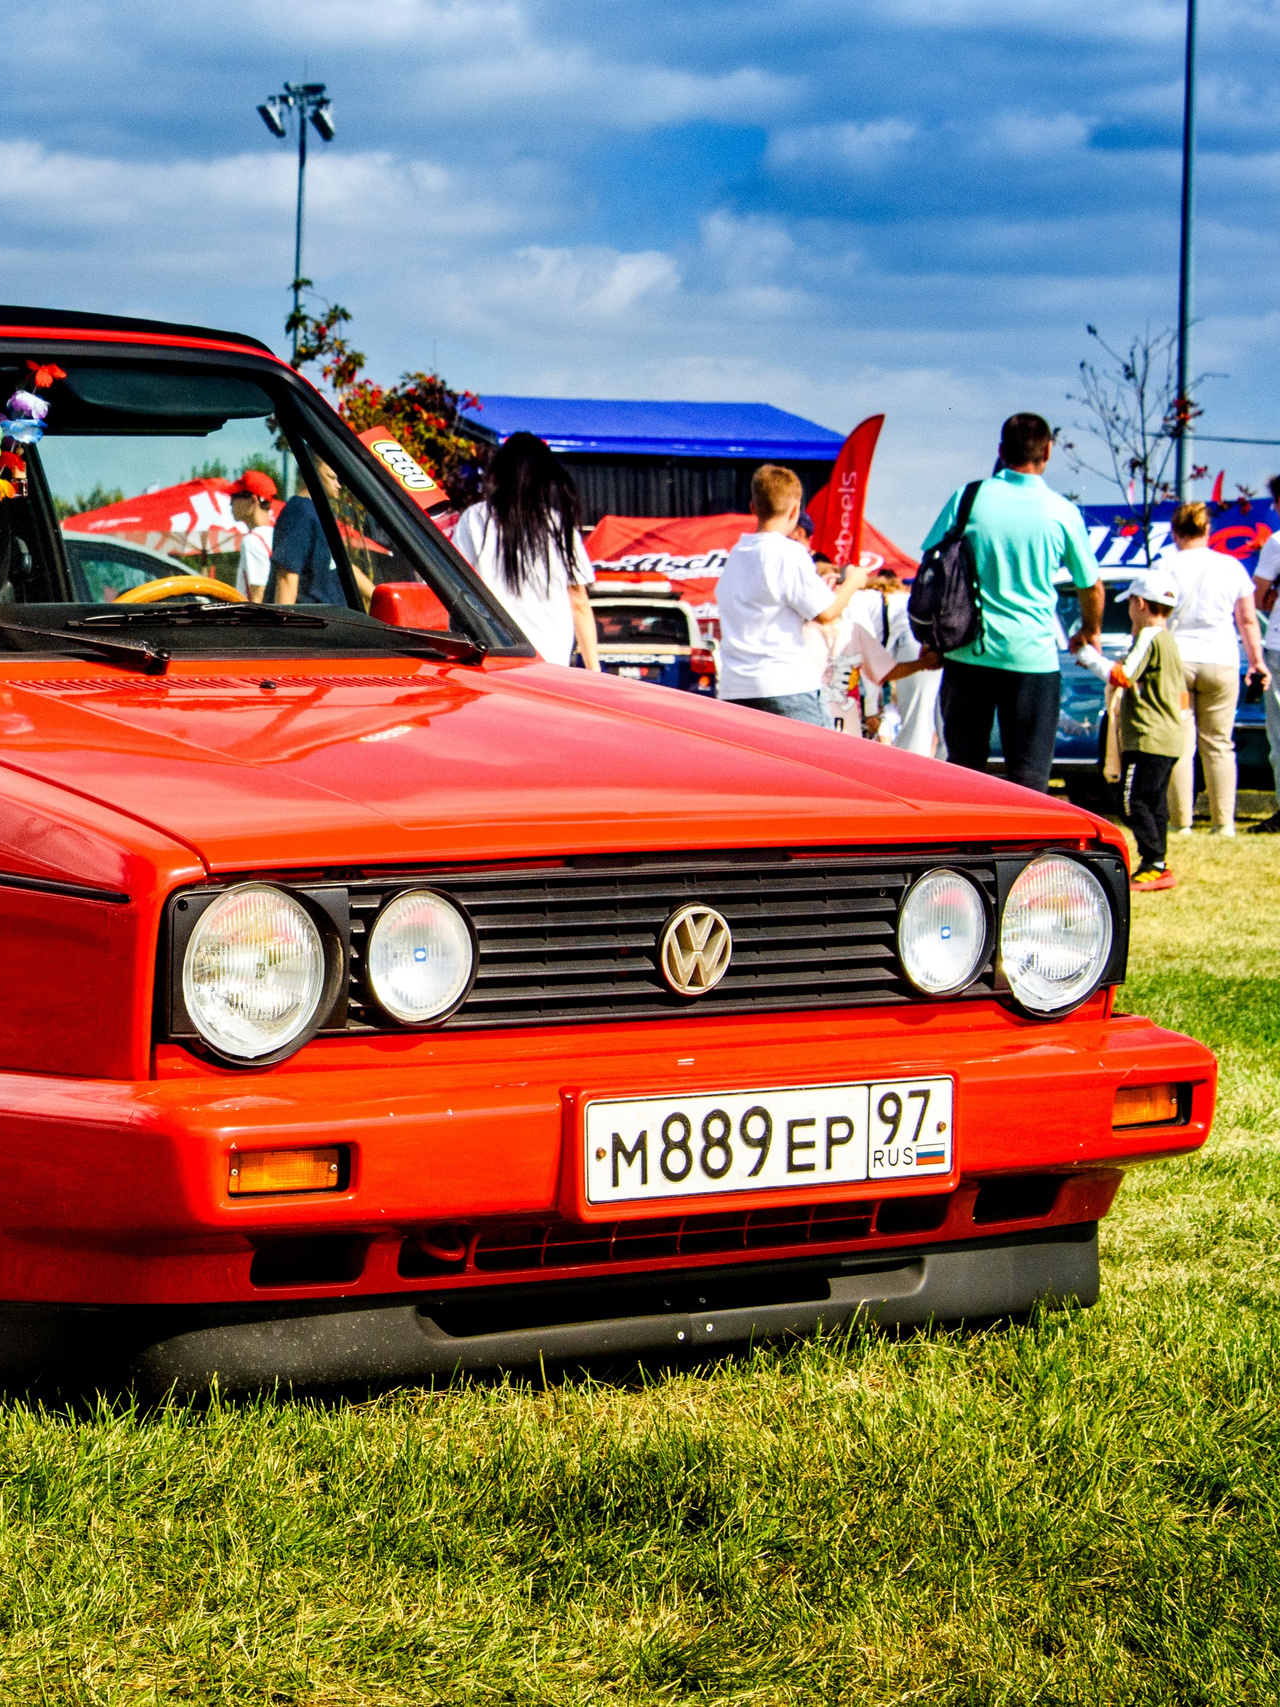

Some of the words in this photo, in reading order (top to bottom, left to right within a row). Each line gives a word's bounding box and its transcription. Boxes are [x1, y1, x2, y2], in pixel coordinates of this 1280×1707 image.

[373, 442, 434, 488] LEGO
[662, 905, 732, 995] VW
[877, 1088, 931, 1146] 97
[872, 1146, 914, 1169] RUS
